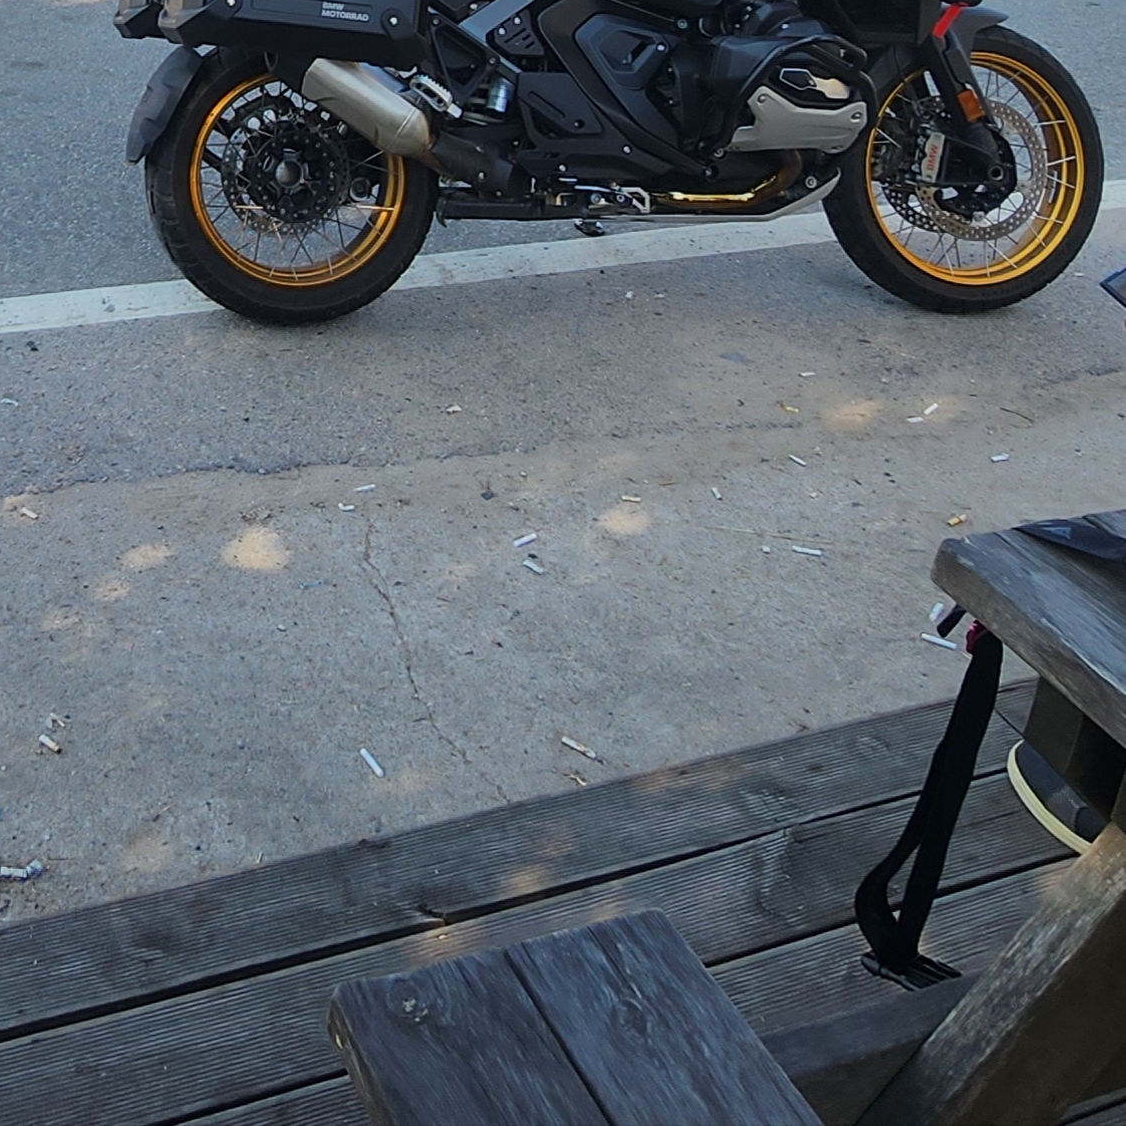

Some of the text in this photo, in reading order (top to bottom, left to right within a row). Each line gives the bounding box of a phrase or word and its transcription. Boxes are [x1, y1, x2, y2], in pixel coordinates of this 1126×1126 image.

[322, 1, 345, 11] BMW
[321, 10, 369, 22] MOTORRAD
[926, 144, 940, 172] BMW
